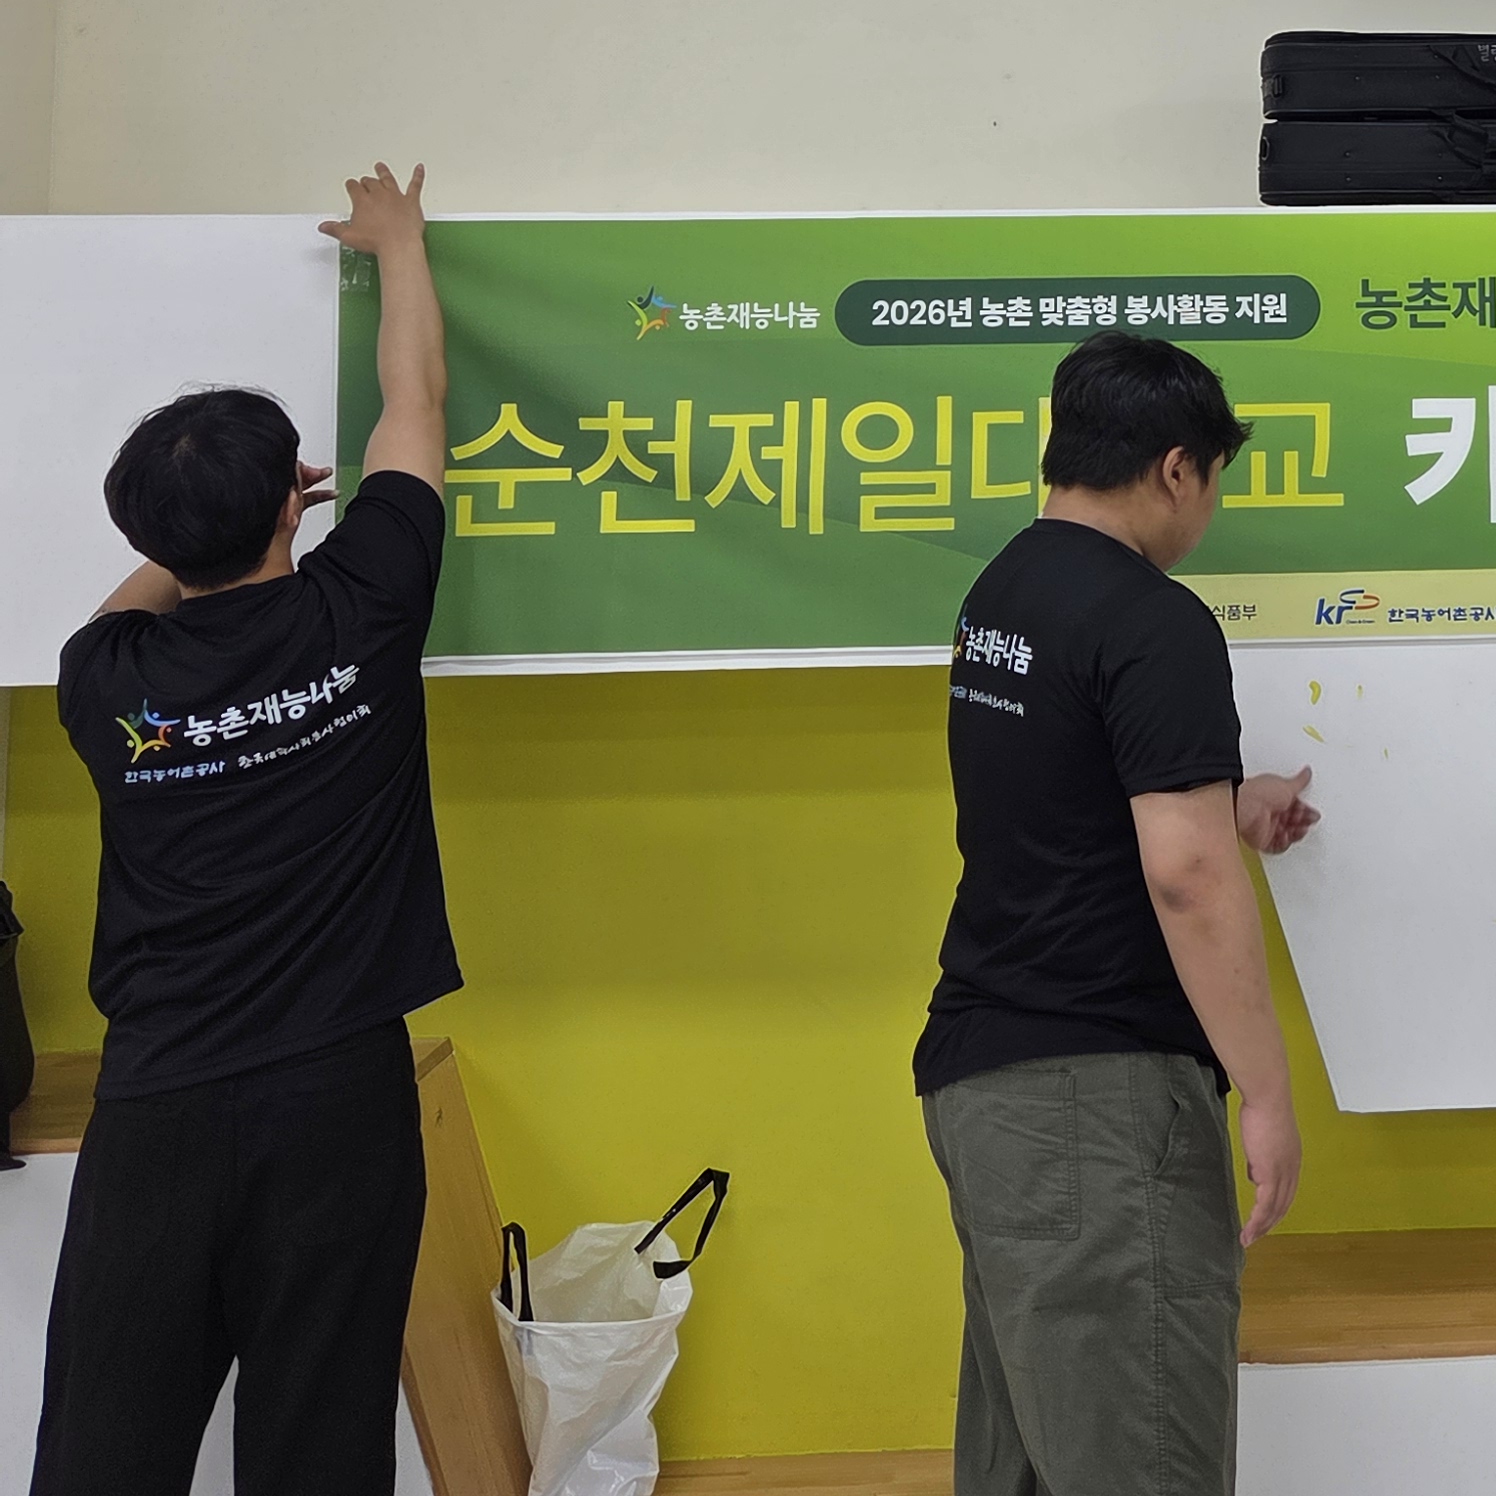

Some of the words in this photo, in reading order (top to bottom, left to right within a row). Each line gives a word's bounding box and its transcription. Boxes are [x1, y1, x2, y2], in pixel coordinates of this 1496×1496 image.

[679, 301, 821, 330] 농촌재능나눔
[871, 297, 973, 327] 2026년
[979, 295, 1034, 327] 농촌
[1038, 294, 1119, 327] 맞춤형
[1123, 293, 1229, 325] 봉사활동
[1234, 292, 1288, 324] 지원
[445, 395, 1345, 538] 순천제일대교
[966, 626, 1033, 675] 농촌재능나눔
[184, 664, 360, 747] 농촌재능나눔
[124, 760, 227, 784] 한국농어촌공사
